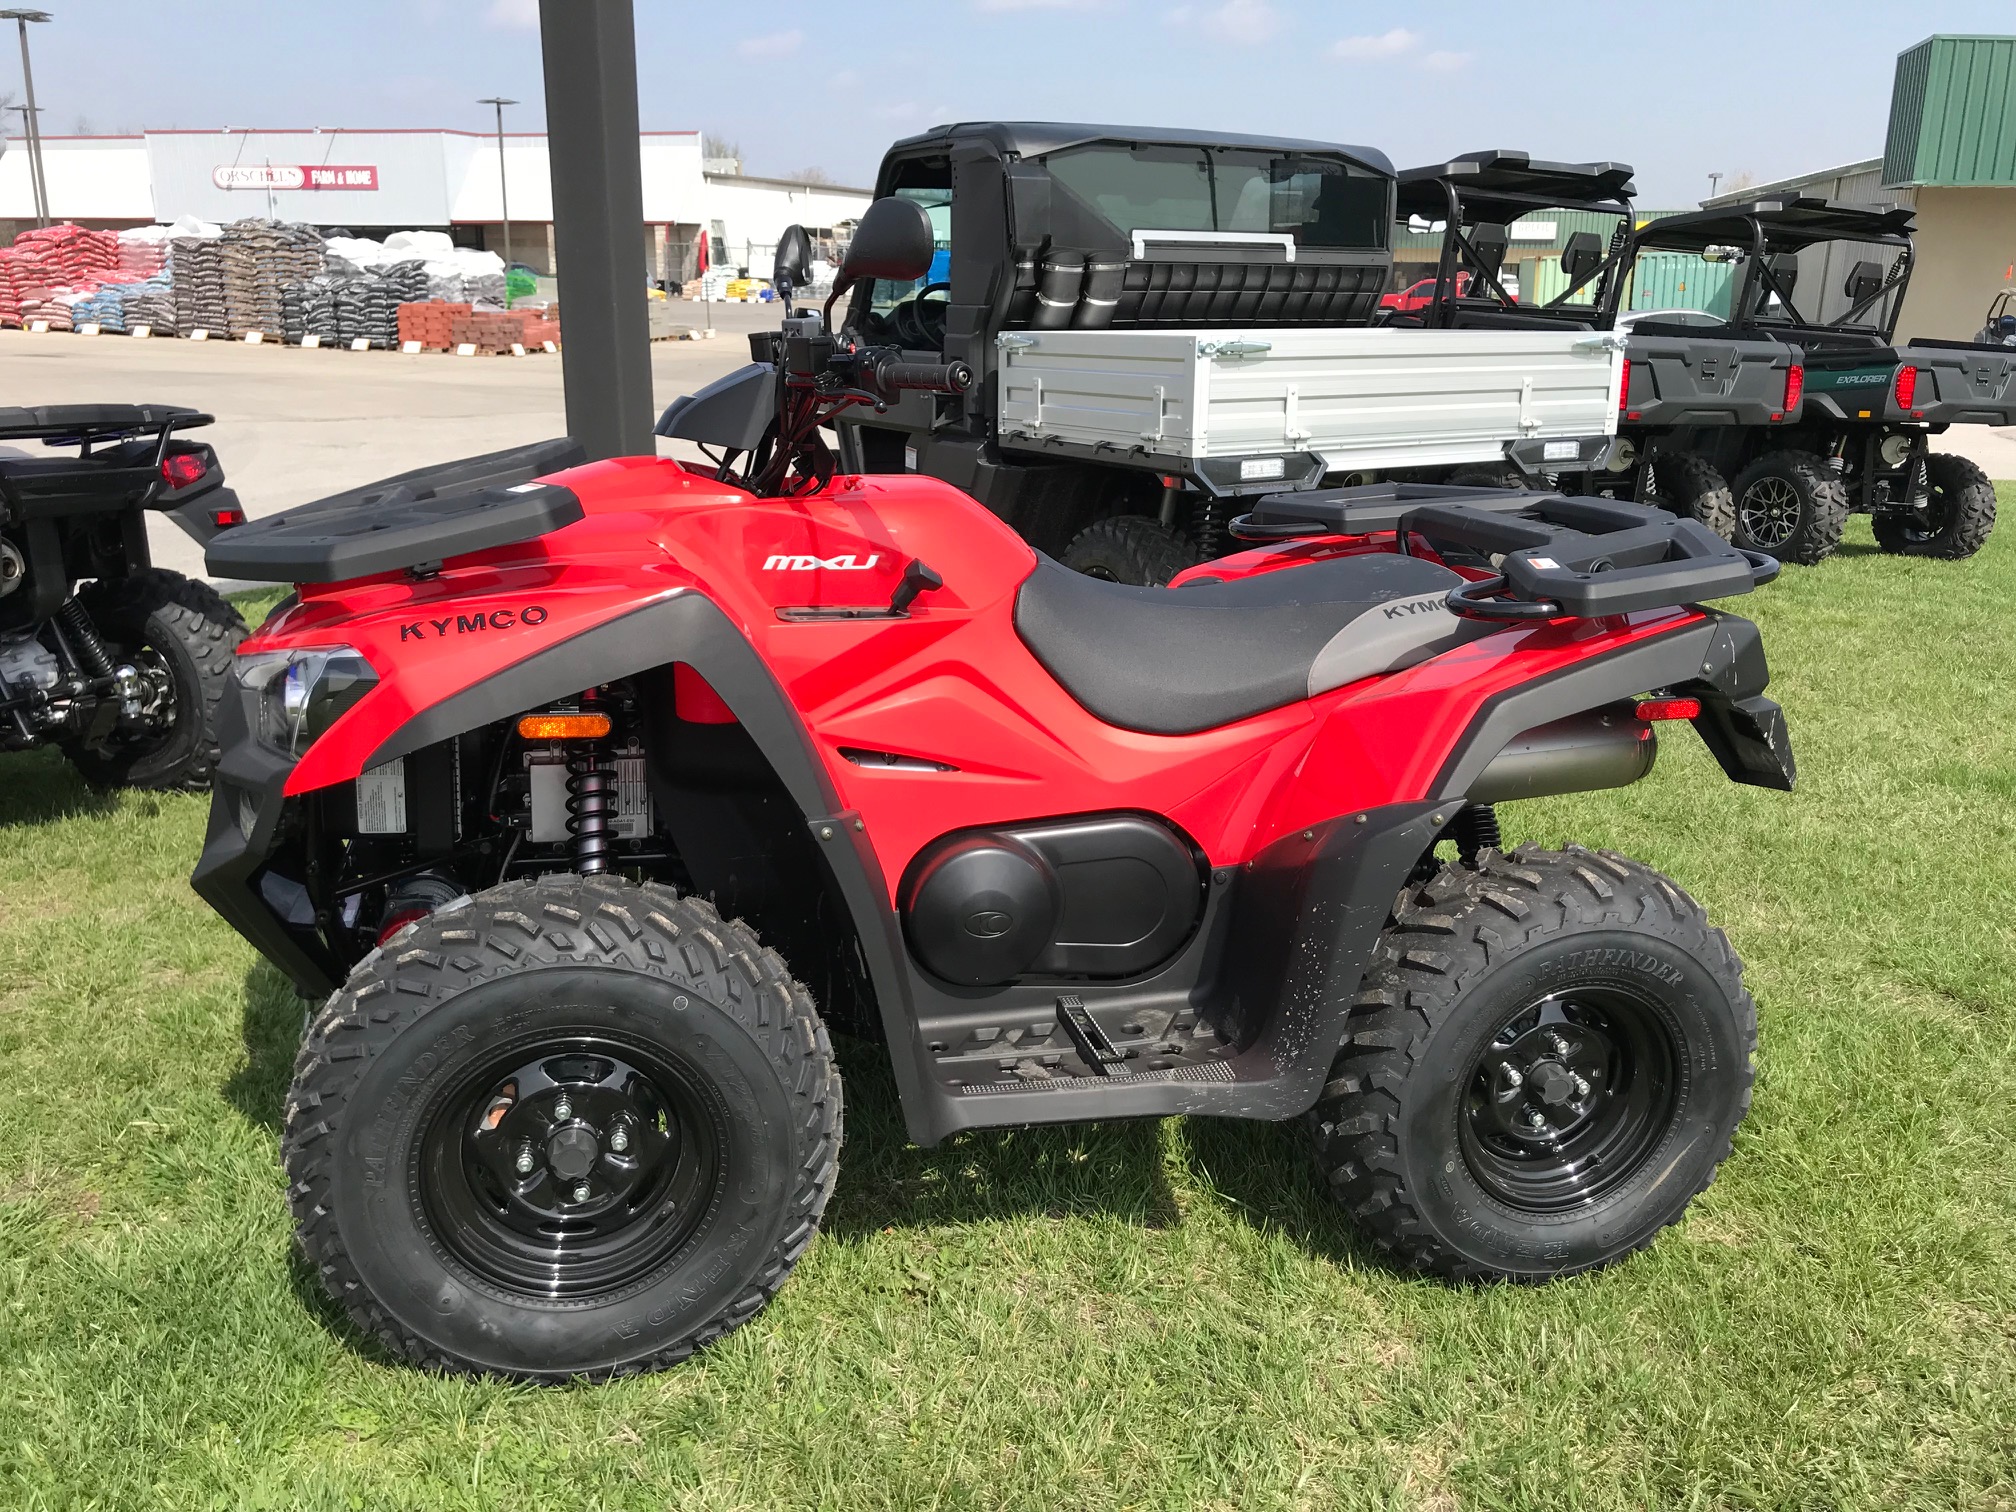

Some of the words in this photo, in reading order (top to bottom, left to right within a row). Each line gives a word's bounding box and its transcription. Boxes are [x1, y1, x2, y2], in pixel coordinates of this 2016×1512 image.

[311, 170, 336, 184] FARM
[337, 172, 344, 185] &
[345, 170, 372, 185] HOME
[1836, 375, 1887, 384] EXPLORER
[762, 554, 880, 571] MXU
[400, 605, 549, 642] KYMCO
[1537, 948, 1686, 990] PATHFINDER
